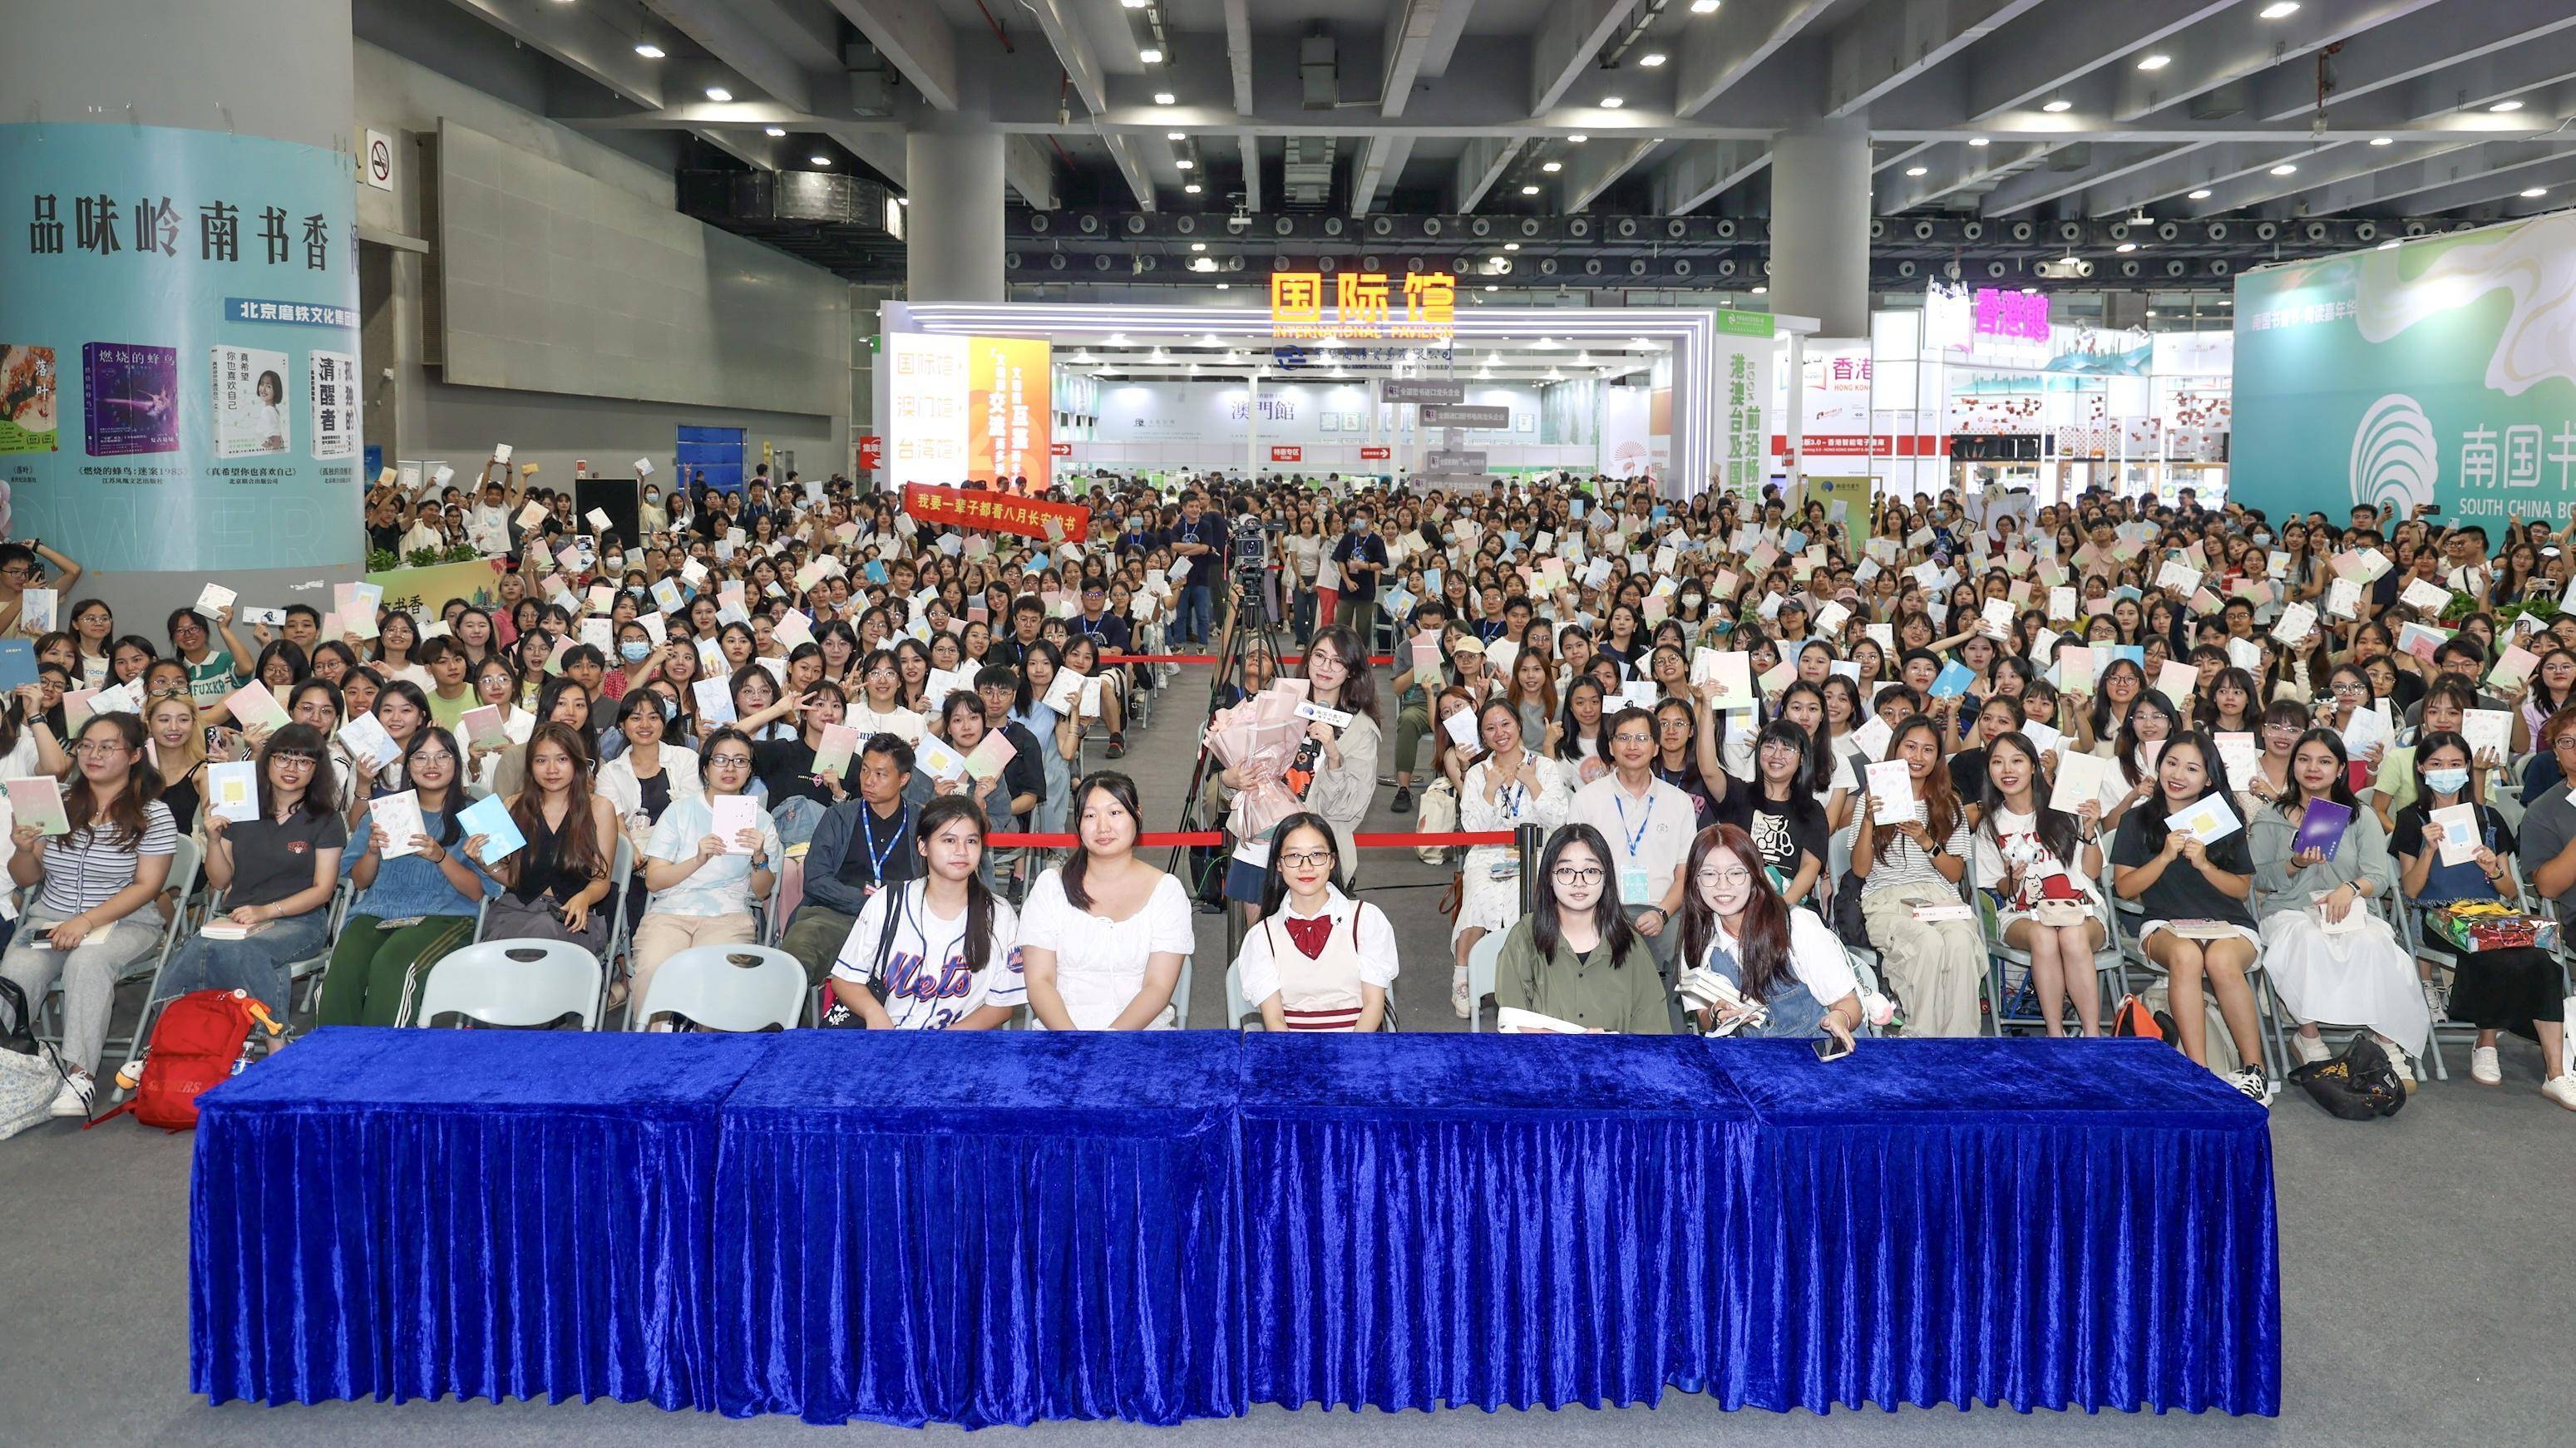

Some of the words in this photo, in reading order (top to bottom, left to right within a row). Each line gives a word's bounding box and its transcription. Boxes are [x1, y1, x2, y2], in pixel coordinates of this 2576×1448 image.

[30, 193, 329, 271] 品味岭南书香
[1271, 271, 1454, 323] 国际馆
[1273, 325, 1382, 338] INTERNATIONAL
[1390, 325, 1454, 338] PAVILION
[36, 359, 49, 401] 落叶
[226, 351, 238, 411] 你也喜欢自己
[240, 352, 249, 382] 真希望
[319, 357, 336, 431] 清醒者
[1231, 400, 1295, 421] 澳門館
[2459, 498, 2504, 516] SOUTH
[2508, 500, 2552, 519] CHINA
[883, 951, 972, 1002] Mets
